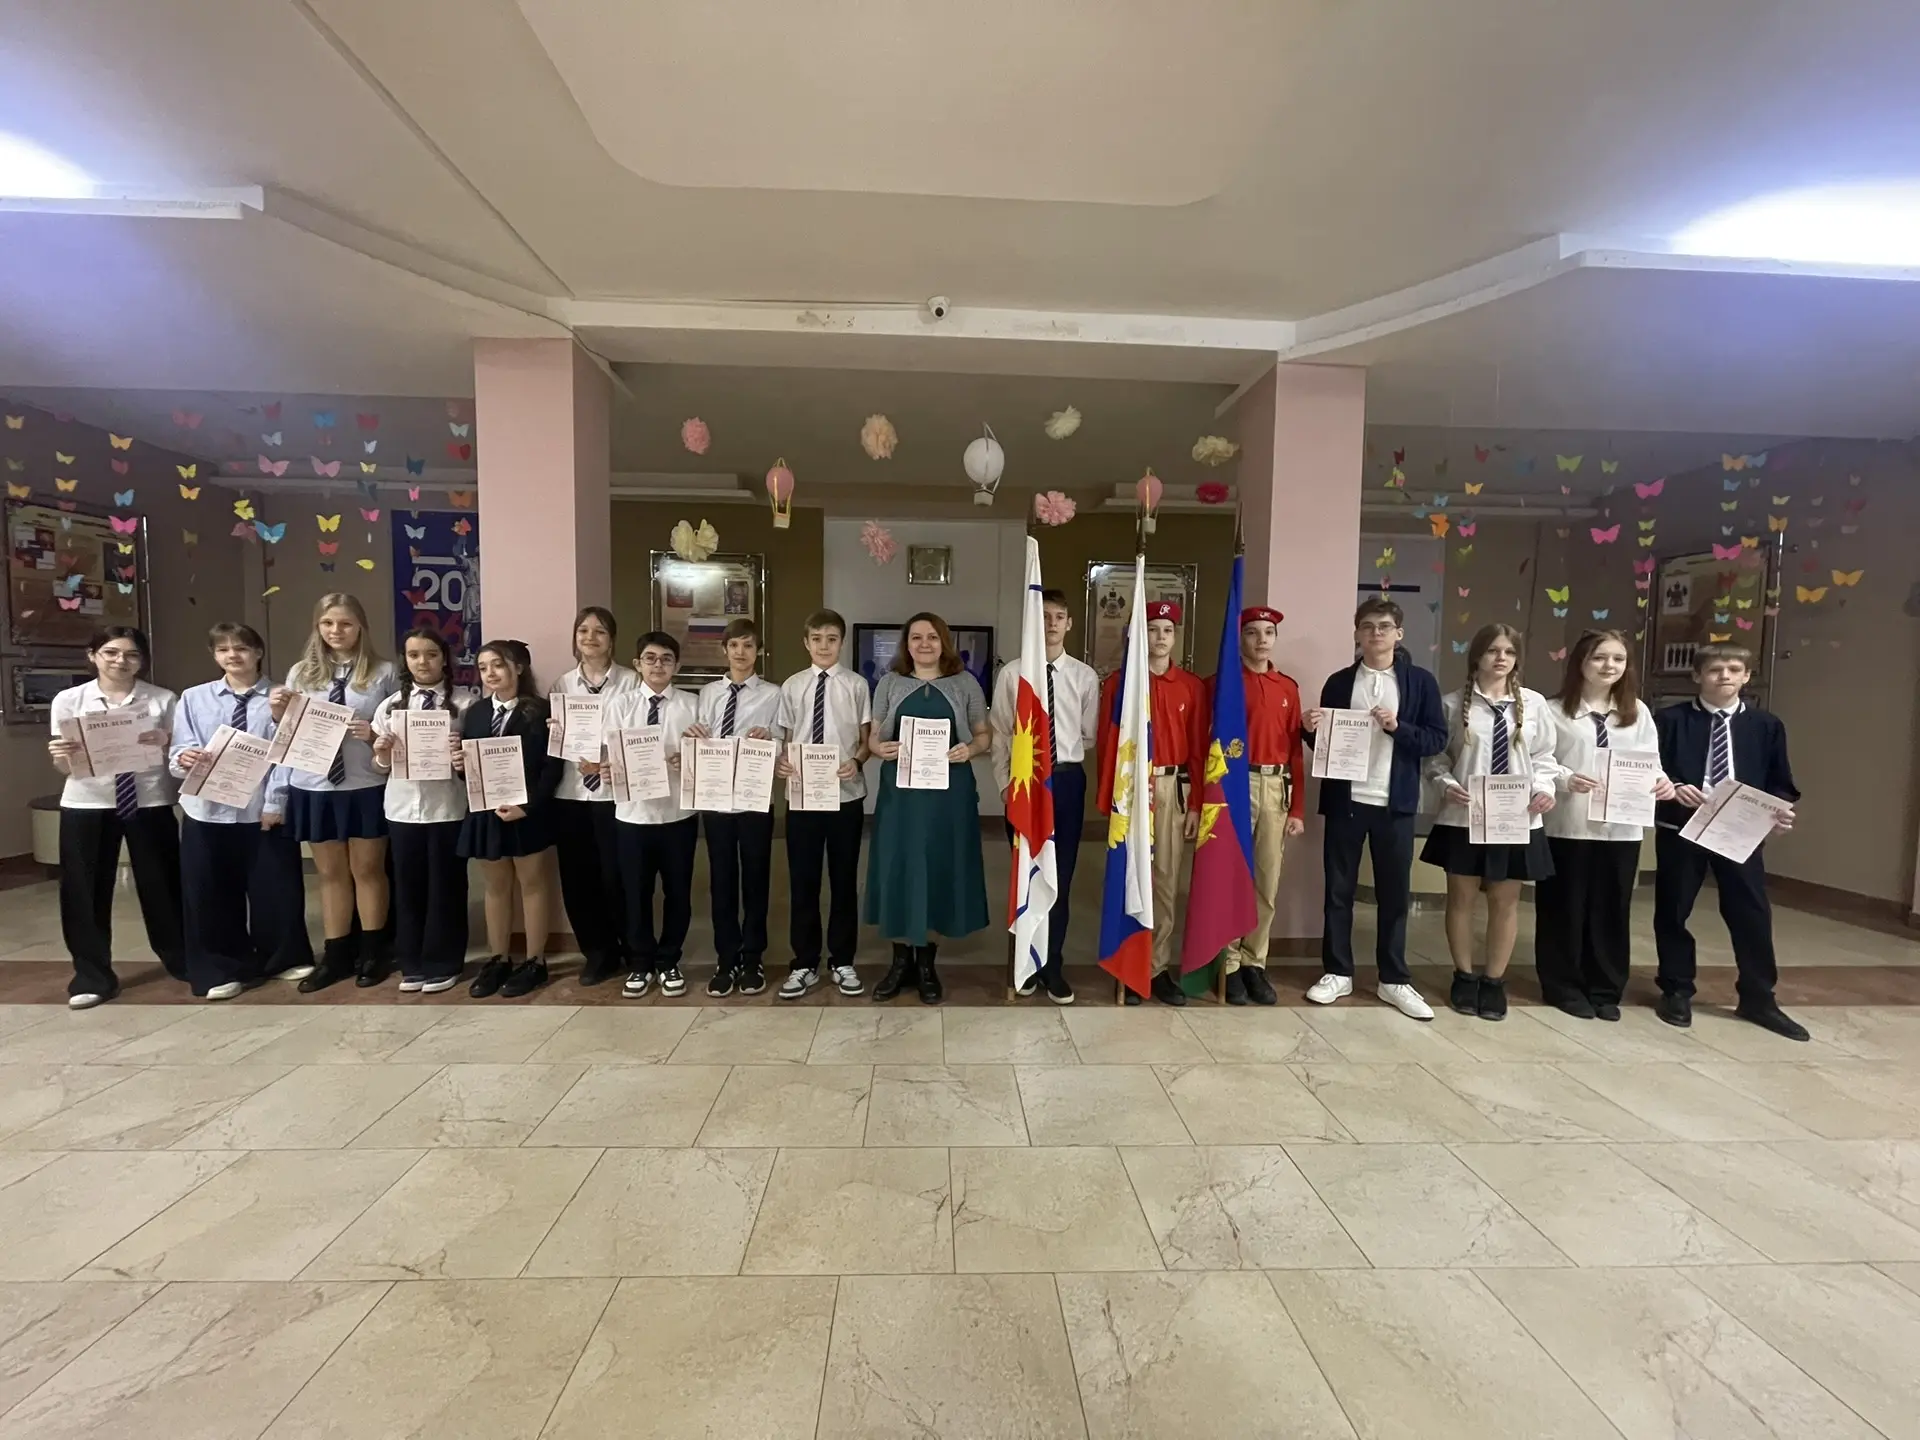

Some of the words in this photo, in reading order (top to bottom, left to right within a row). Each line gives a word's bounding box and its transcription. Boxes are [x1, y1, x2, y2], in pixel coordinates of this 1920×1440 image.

[411, 570, 466, 611] 20
[568, 703, 599, 711] ДИПЛОМ
[308, 707, 347, 723] ДИПЛОМ
[410, 720, 446, 728] ДИПЛОМ
[1334, 719, 1369, 728] ДИПЛОМ
[916, 728, 947, 736] ДИПЛОМ
[626, 735, 660, 747] ДИПЛОМ
[482, 746, 519, 757] ДИПЛОМ
[699, 748, 731, 757] ДИПЛОМ
[740, 748, 773, 759] ДИПЛОМ
[804, 753, 837, 761] ДИПЛОМ
[1613, 759, 1653, 770] ДИПЛОМ
[1487, 783, 1526, 792] ДИПЛОМ
